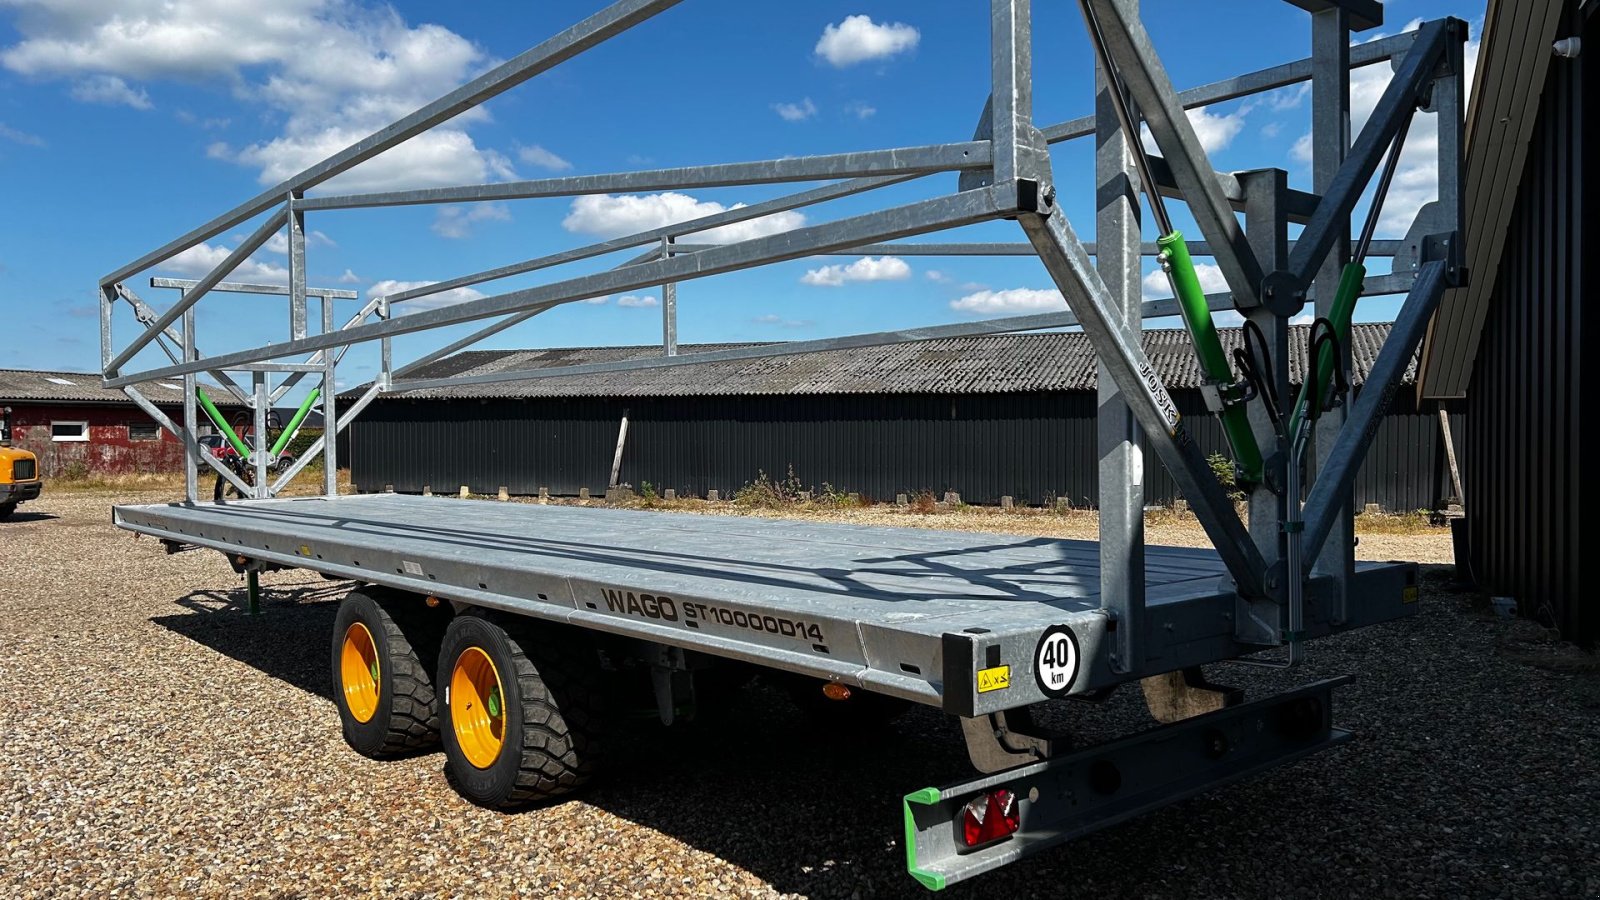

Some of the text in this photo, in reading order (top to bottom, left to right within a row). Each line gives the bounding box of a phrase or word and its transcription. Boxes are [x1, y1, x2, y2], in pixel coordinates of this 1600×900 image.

[601, 588, 823, 642] WAGO ST10000D14
[1043, 638, 1068, 669] 40
[1051, 672, 1064, 684] km
